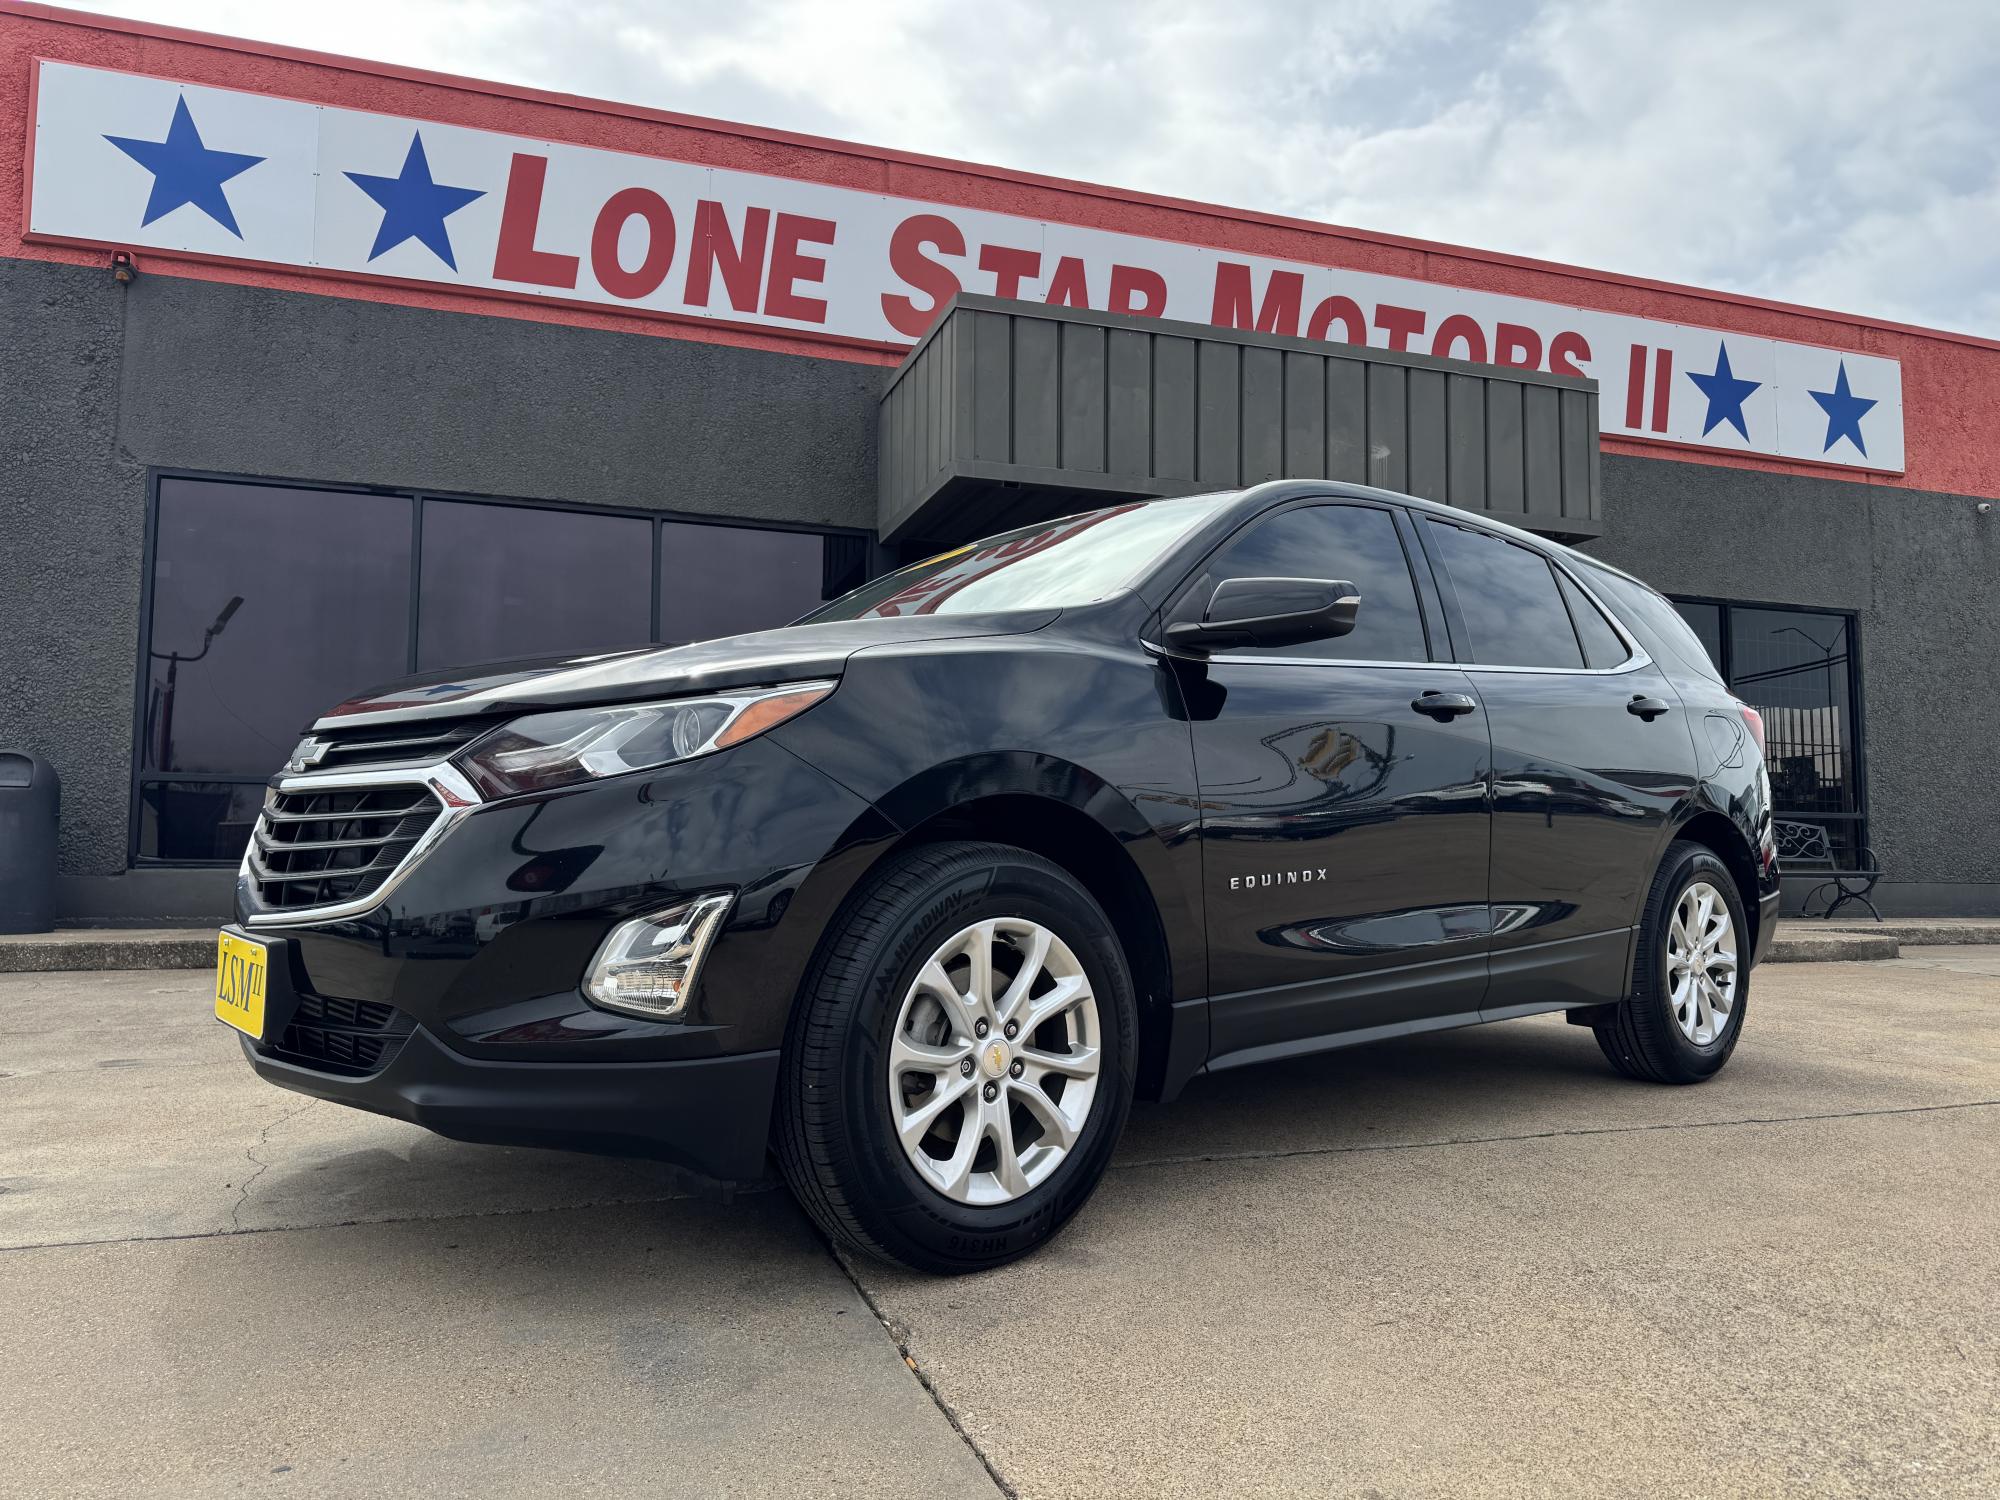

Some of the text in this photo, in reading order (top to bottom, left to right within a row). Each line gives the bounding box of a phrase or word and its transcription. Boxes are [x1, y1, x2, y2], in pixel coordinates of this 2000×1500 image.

[493, 152, 837, 324] LONE
[1625, 343, 1673, 433] II
[1230, 868, 1327, 889] EQUINOX
[894, 888, 964, 962] HEADWAY
